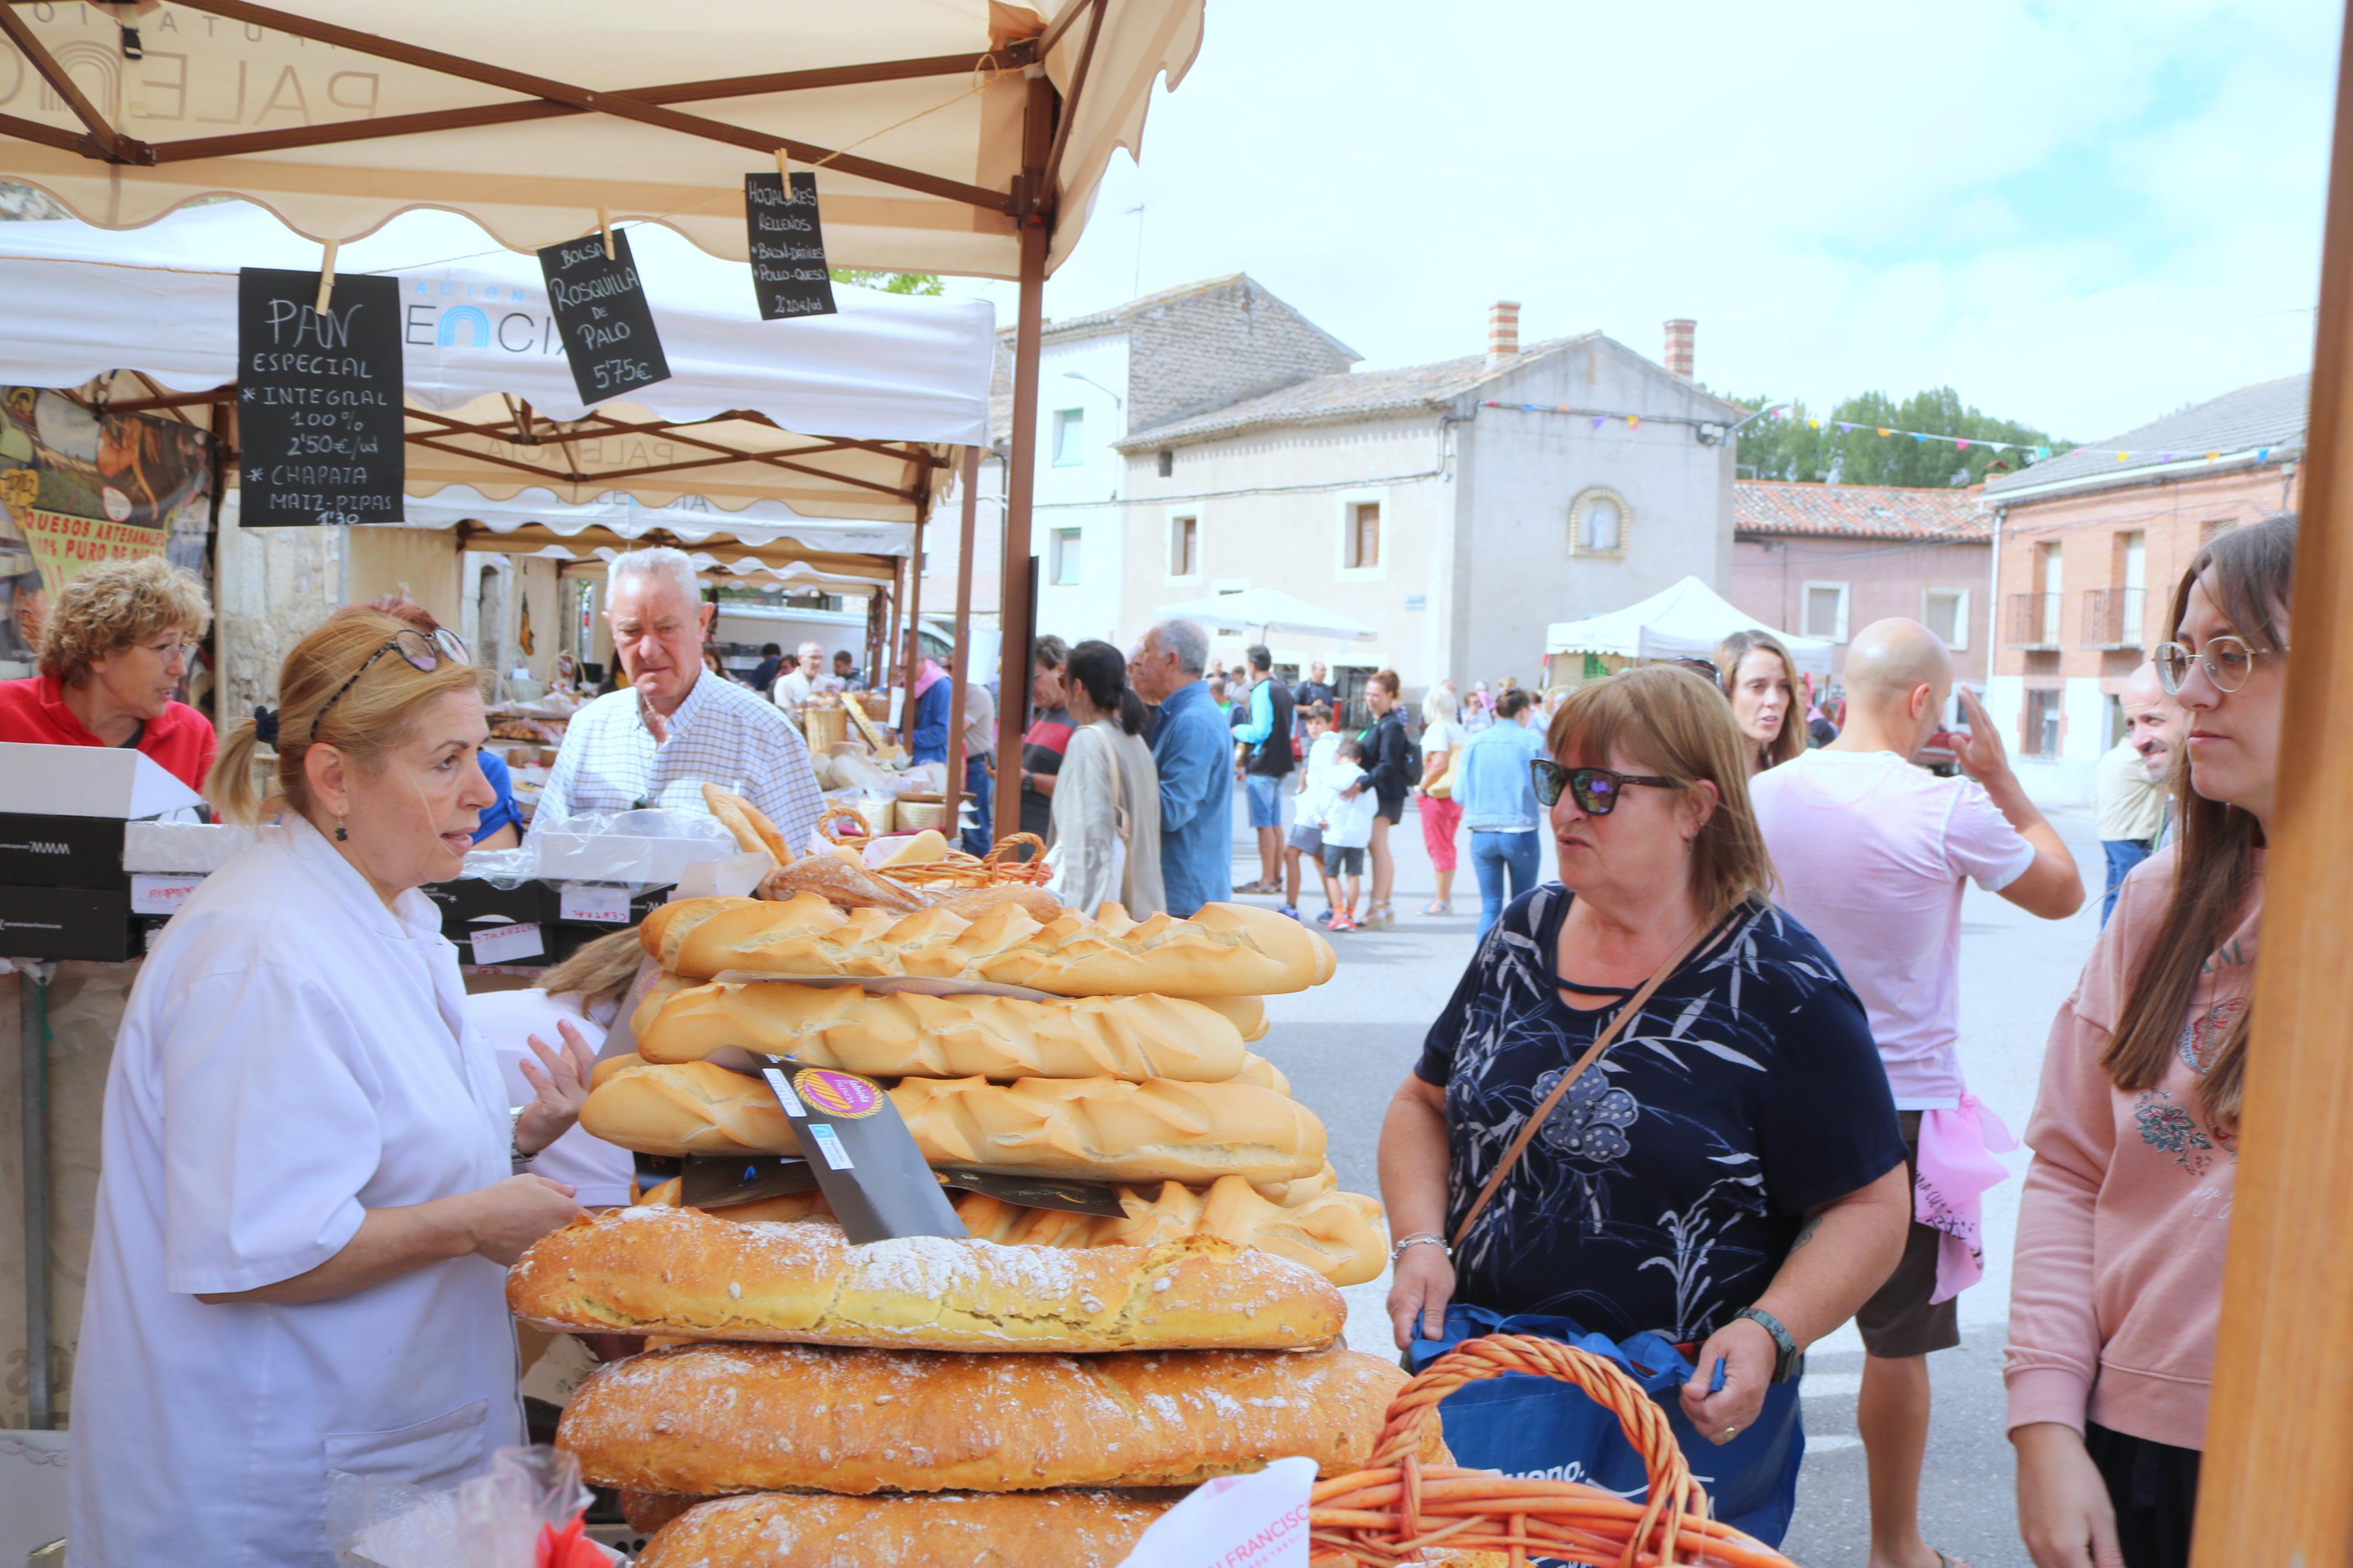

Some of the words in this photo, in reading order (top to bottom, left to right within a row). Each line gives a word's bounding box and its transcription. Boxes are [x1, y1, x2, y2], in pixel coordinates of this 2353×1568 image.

[560, 242, 605, 269] BOLSA
[549, 266, 640, 311] ROSQUILLA
[264, 298, 364, 349] PAN
[591, 305, 609, 320] DE
[577, 321, 630, 351] PALO
[253, 353, 373, 378] ESPECIAL
[262, 386, 388, 406] INTEGRAL
[271, 465, 368, 485] CHAPATA
[25, 511, 91, 538] QUESOS
[65, 539, 106, 561] PURO
[1225, 1499, 1310, 1568] FRANCISC
